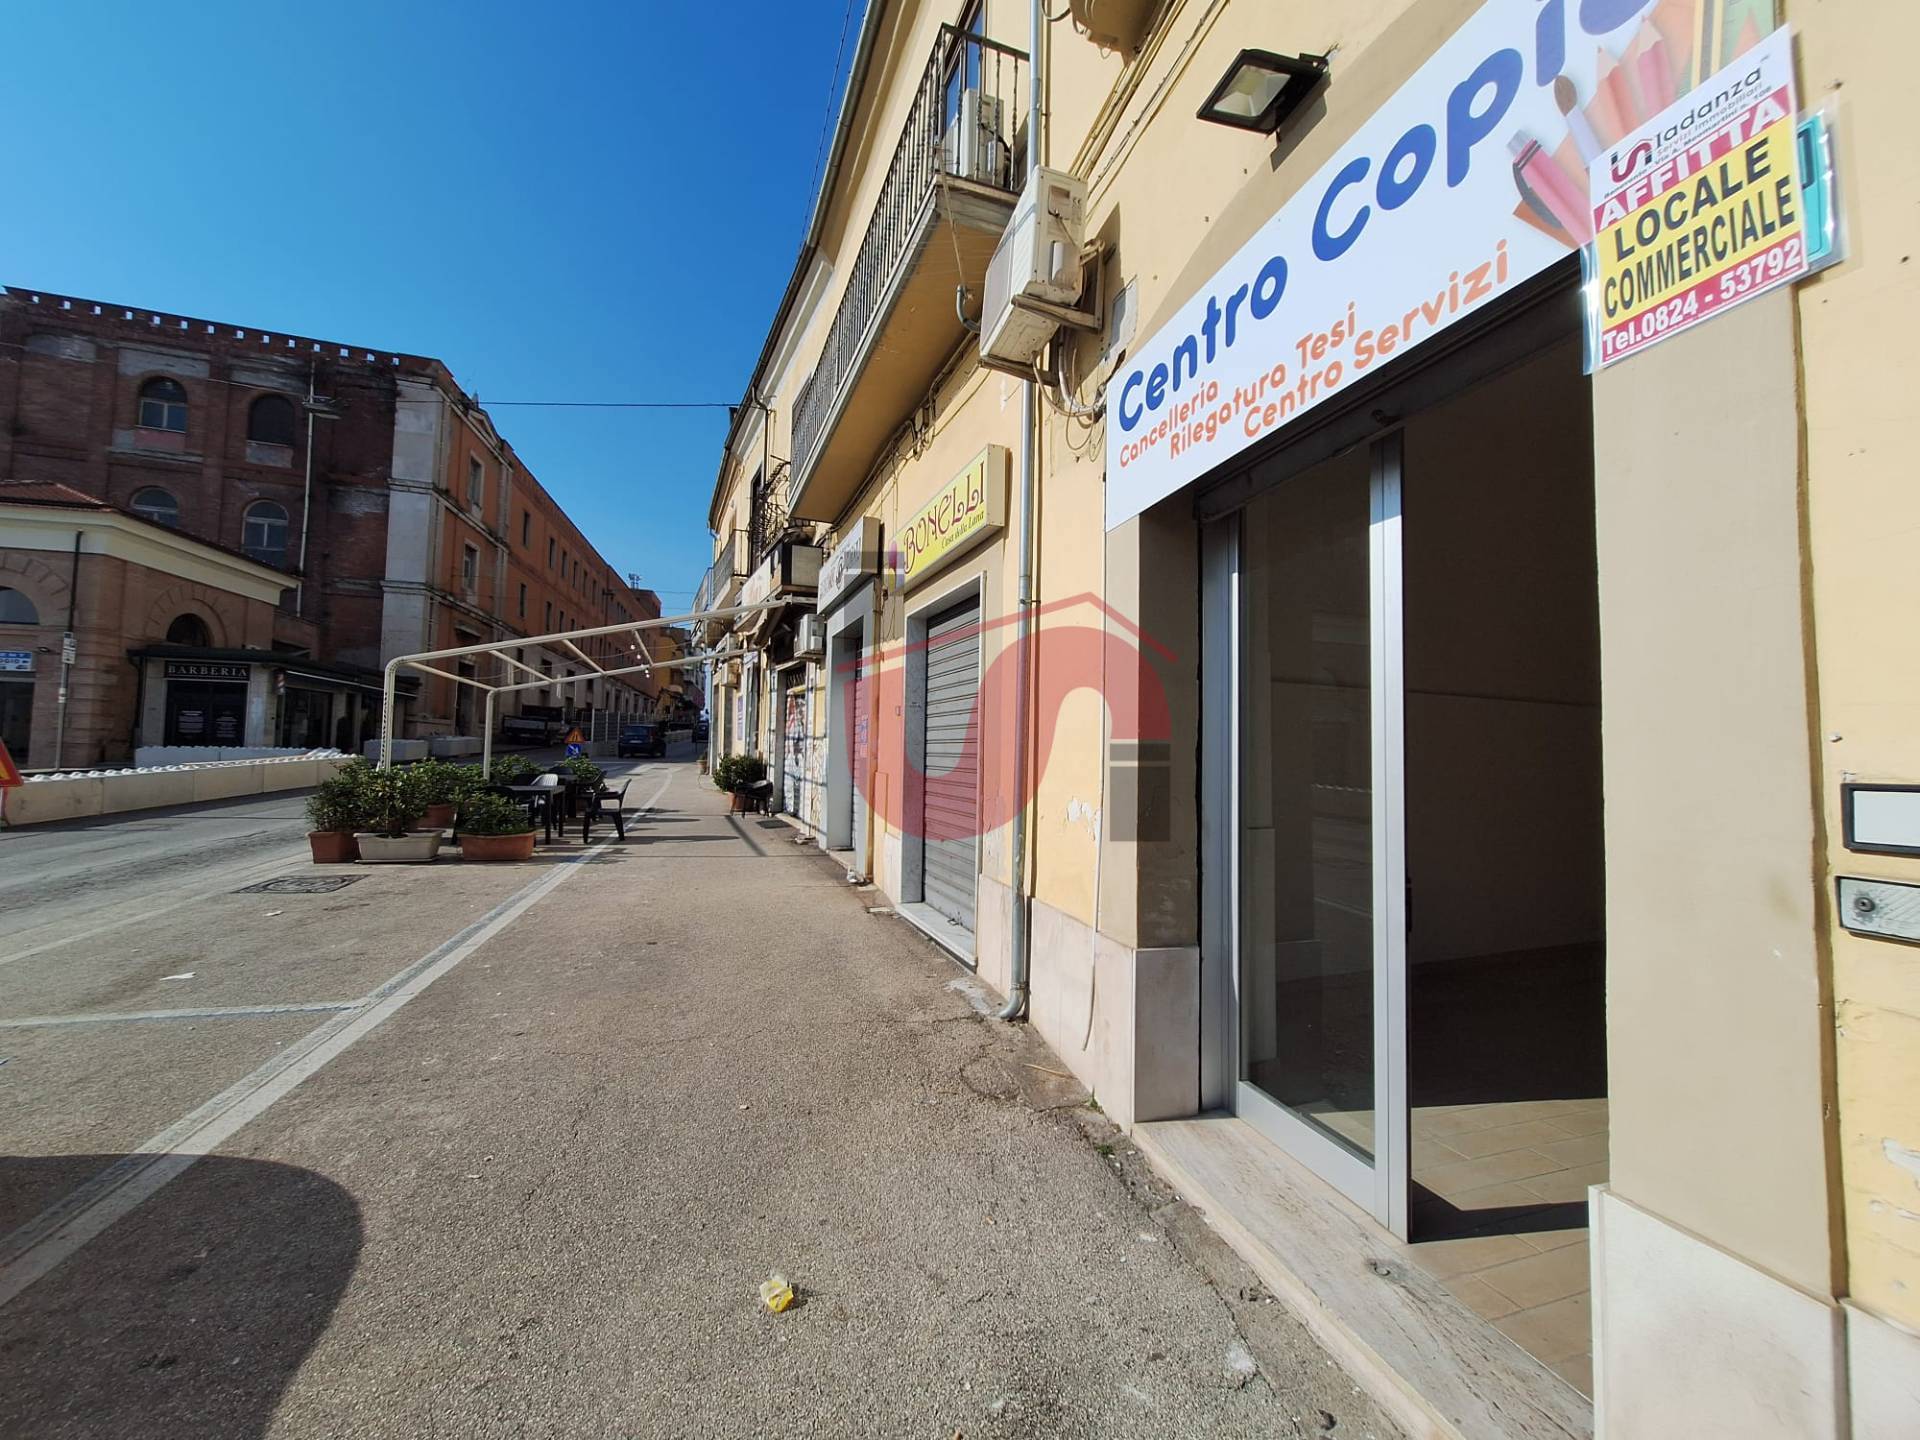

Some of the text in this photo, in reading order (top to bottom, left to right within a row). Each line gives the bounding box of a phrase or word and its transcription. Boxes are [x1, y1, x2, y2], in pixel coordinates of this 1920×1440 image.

[1600, 96, 1786, 230] AFFITTA
[1615, 137, 1771, 262] LOCALE
[1603, 289, 1698, 355] Tel.0824
[1720, 237, 1801, 301] 53792
[1604, 174, 1795, 318] COMMERCIALE
[1119, 255, 1288, 432] Centro
[1170, 301, 1357, 460] Rilegatura Tesi
[1243, 239, 1509, 438] Centro Servizi
[1119, 380, 1219, 468] Cancelleria
[168, 664, 248, 677] BARBERIA
